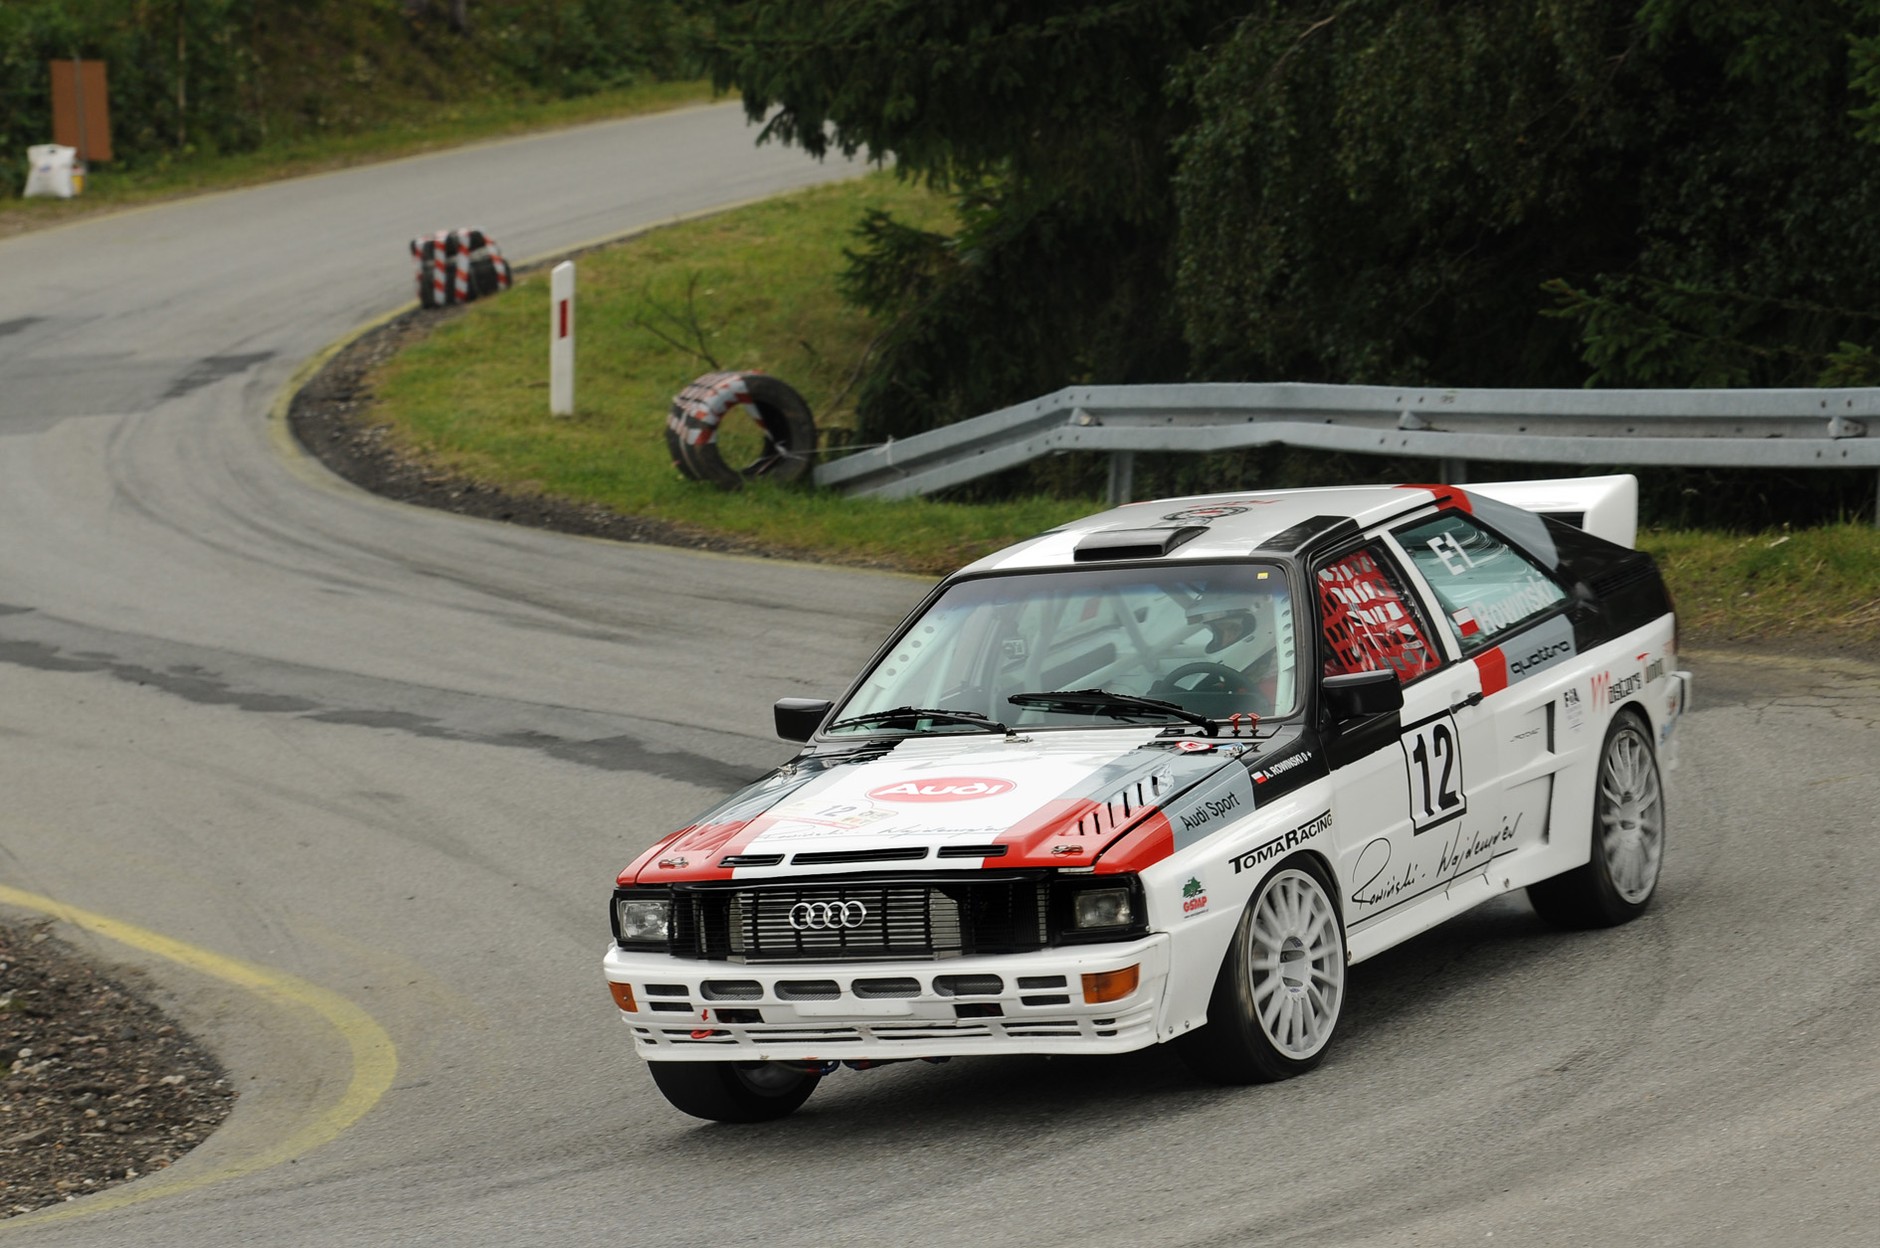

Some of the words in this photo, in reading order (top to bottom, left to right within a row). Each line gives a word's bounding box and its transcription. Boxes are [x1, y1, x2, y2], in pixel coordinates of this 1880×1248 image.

[1510, 640, 1571, 675] quattro
[1413, 723, 1460, 817] 12
[873, 780, 1004, 798] Audi
[815, 804, 857, 817] 12
[1180, 806, 1210, 831] Audi
[1204, 791, 1240, 819] Sport
